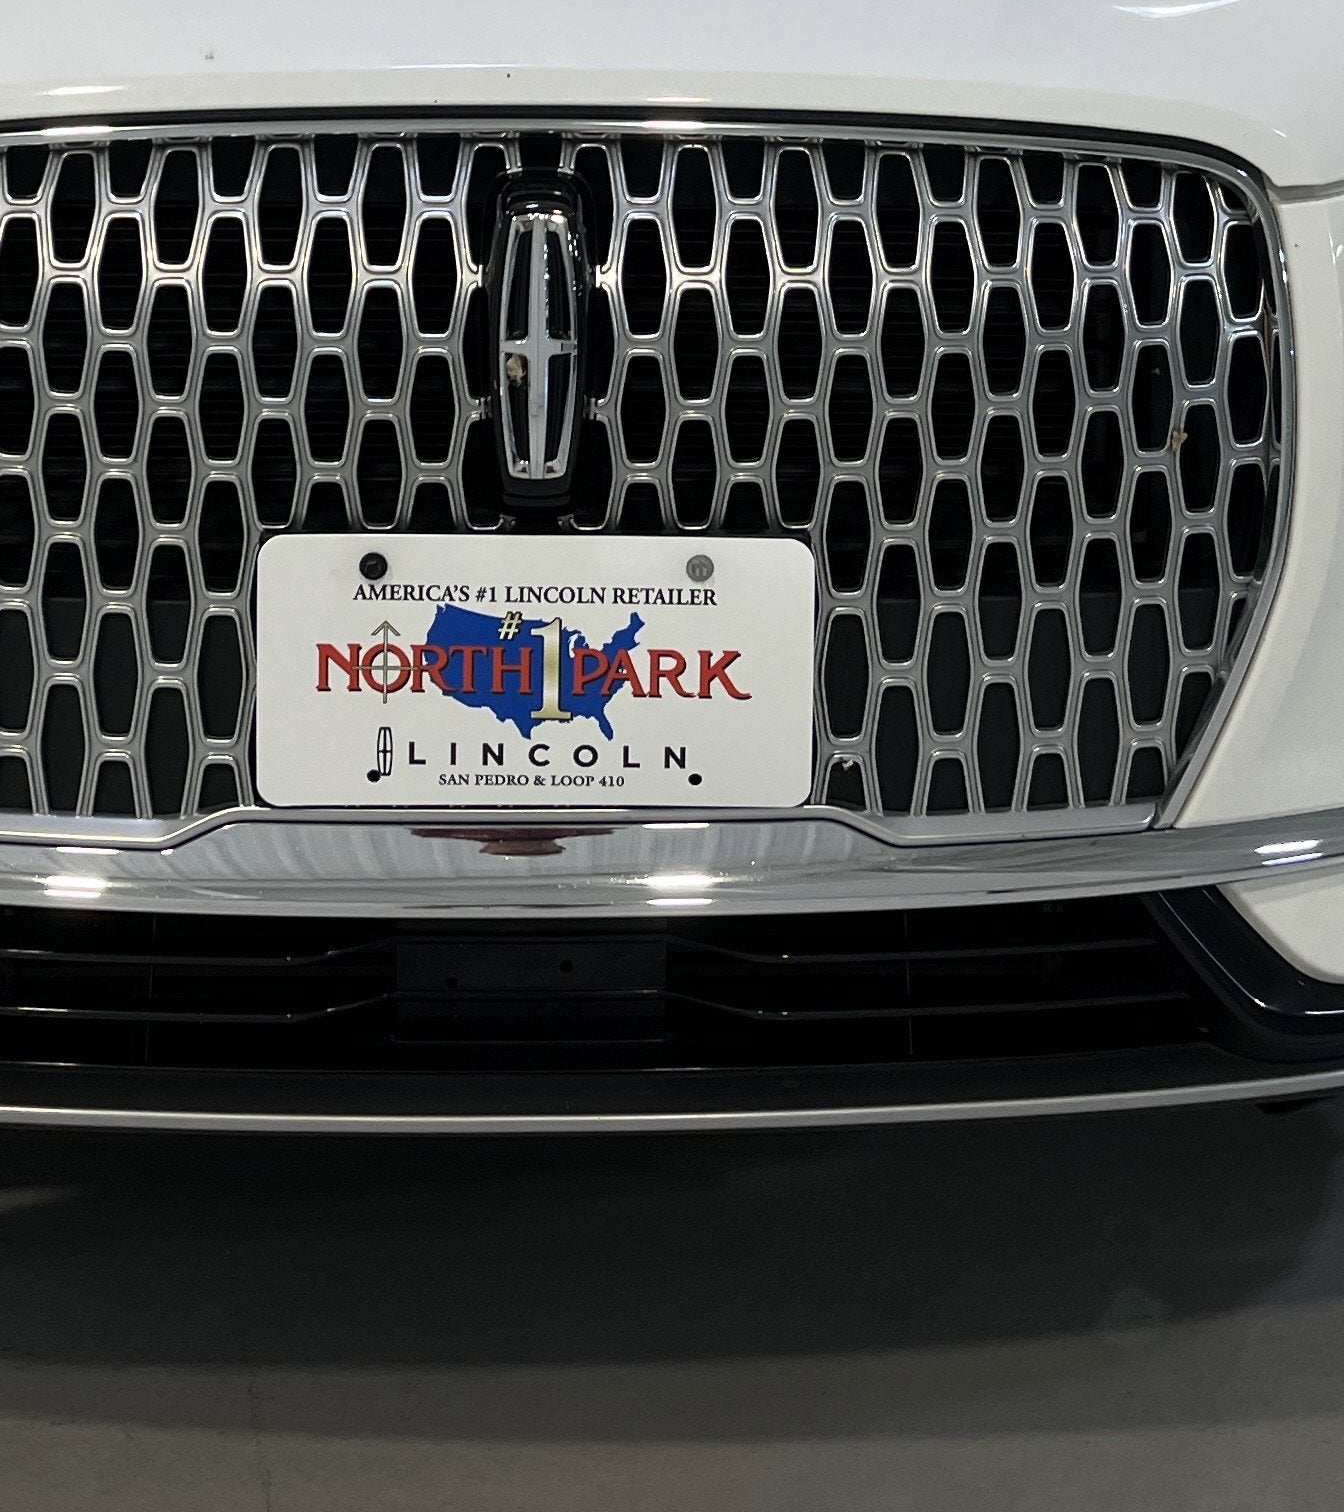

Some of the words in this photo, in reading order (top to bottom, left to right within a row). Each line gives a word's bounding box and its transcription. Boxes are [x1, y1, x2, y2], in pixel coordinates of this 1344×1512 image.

[353, 584, 470, 604] AMERICA'S
[476, 586, 498, 604] #1
[505, 586, 608, 605] LINCOLN
[612, 587, 717, 606] RETAILER
[316, 644, 532, 695] NORTH
[572, 649, 752, 699] PARK
[409, 741, 687, 769] LINCOLN
[439, 774, 470, 786] SAN
[474, 774, 529, 787] PEDRO
[533, 774, 546, 786] &
[551, 775, 595, 787] LOOP
[599, 775, 624, 788] 410
